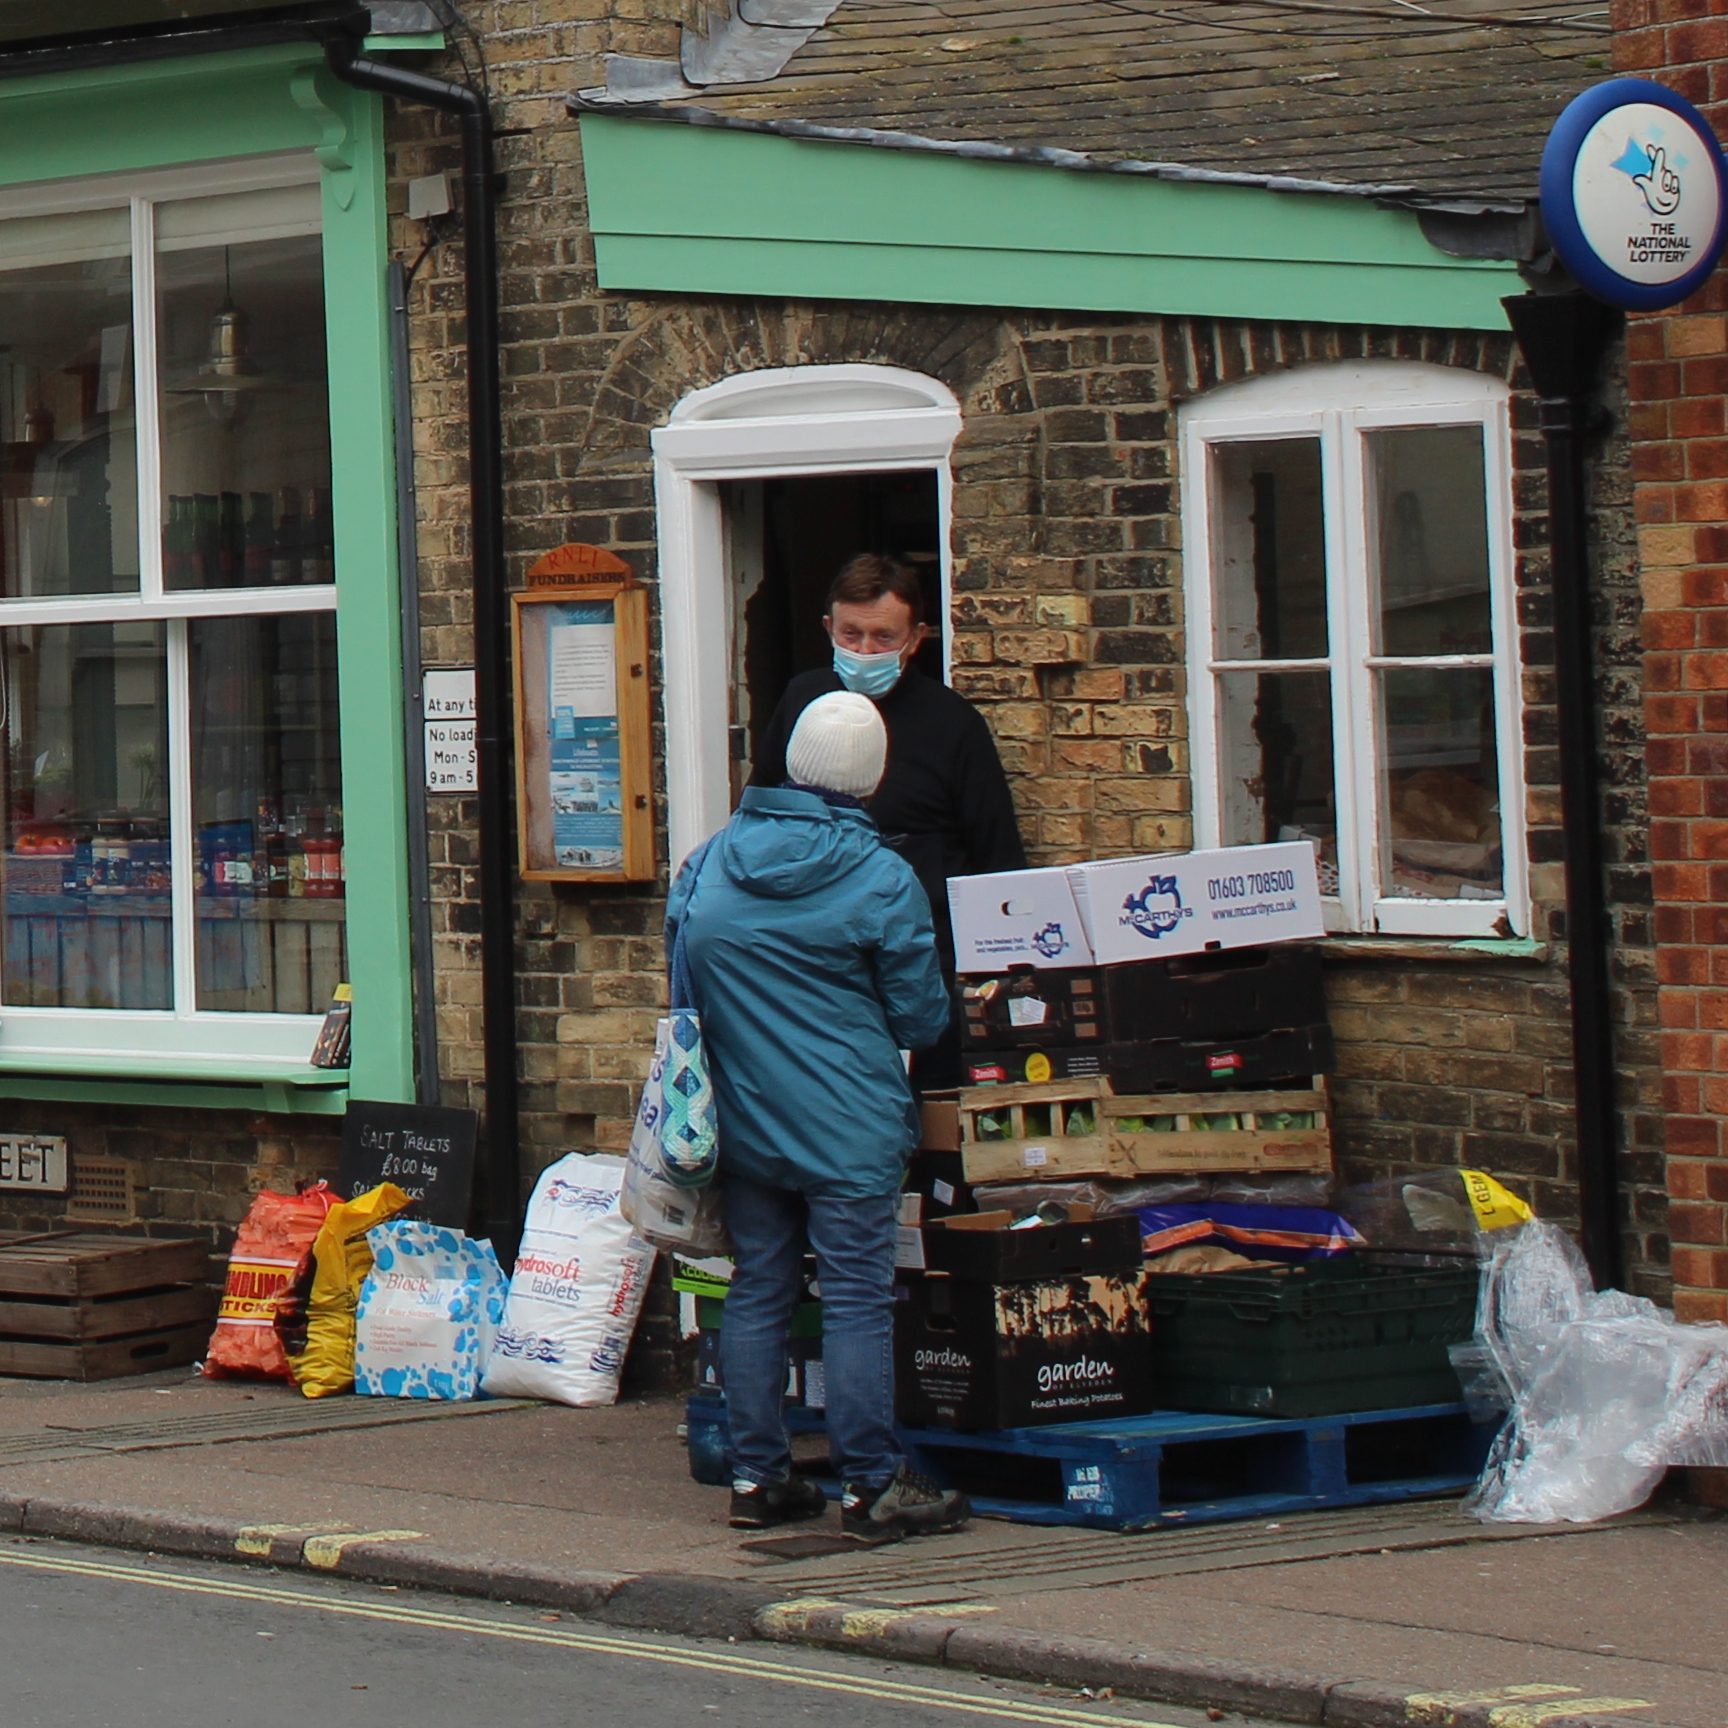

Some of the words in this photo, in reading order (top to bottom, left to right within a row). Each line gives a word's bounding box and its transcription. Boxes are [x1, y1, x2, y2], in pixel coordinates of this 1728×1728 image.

[1650, 222, 1675, 235] THE
[1626, 236, 1691, 249] NATIONAL
[547, 545, 598, 570] RNLI
[529, 572, 625, 587] FUNDRAISERS
[428, 698, 441, 711] At
[445, 700, 465, 713] any
[429, 729, 446, 742] No
[449, 728, 475, 741] load
[434, 751, 458, 764] Mon
[430, 771, 437, 784] 9
[440, 774, 456, 784] am
[1207, 876, 1244, 901] 01603
[1247, 869, 1295, 896] 708500
[1211, 899, 1297, 921] www.mccarthys.co.uk
[360, 1124, 395, 1150] SALT
[402, 1130, 450, 1153] TABLETS
[385, 1272, 431, 1293] Block
[530, 1275, 582, 1303] tablets
[416, 1289, 443, 1306] Salt
[914, 1346, 972, 1370] garden
[1037, 1354, 1114, 1391] garden
[1030, 1398, 1057, 1409] Finest
[1058, 1395, 1091, 1407] Baking
[1090, 1392, 1124, 1403] Potatoes
